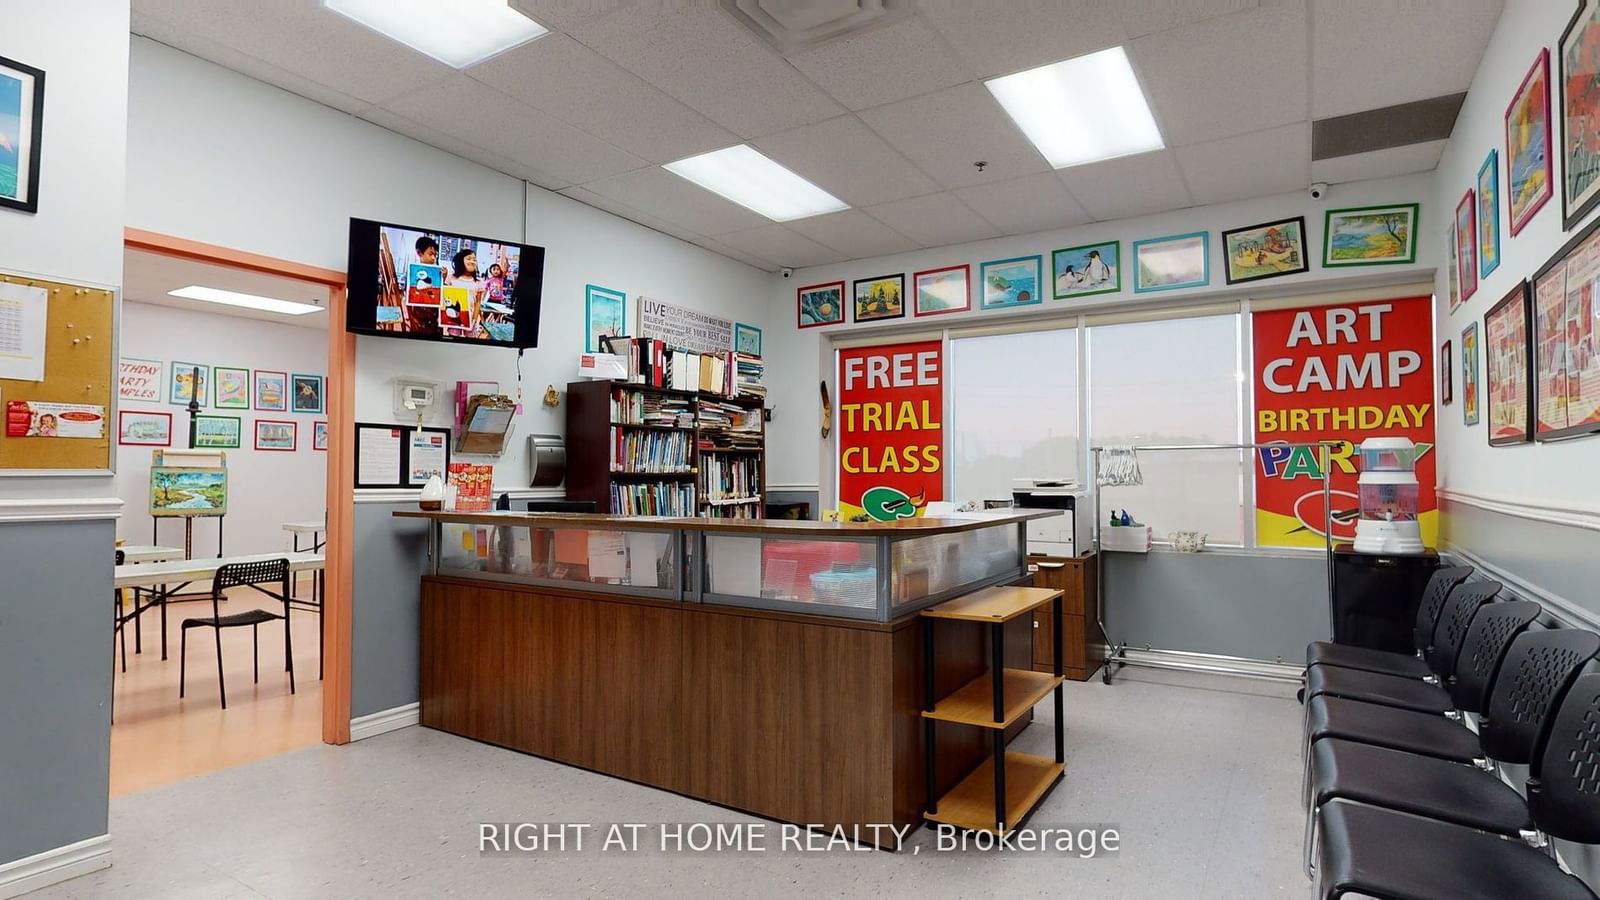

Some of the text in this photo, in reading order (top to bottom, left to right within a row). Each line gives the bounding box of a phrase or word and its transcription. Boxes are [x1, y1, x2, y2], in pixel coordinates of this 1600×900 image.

[644, 300, 666, 317] LIVE
[666, 306, 682, 317] YOUR
[684, 311, 703, 322] DREAM
[644, 315, 664, 326] BELIEVE
[1286, 304, 1392, 348] ART
[708, 331, 719, 341] BEST
[844, 351, 939, 390] FREE
[1262, 350, 1422, 393] CAMP
[842, 399, 941, 432] TRIAL
[1258, 403, 1431, 432] BIRTHDAY
[841, 444, 941, 474] CLASS
